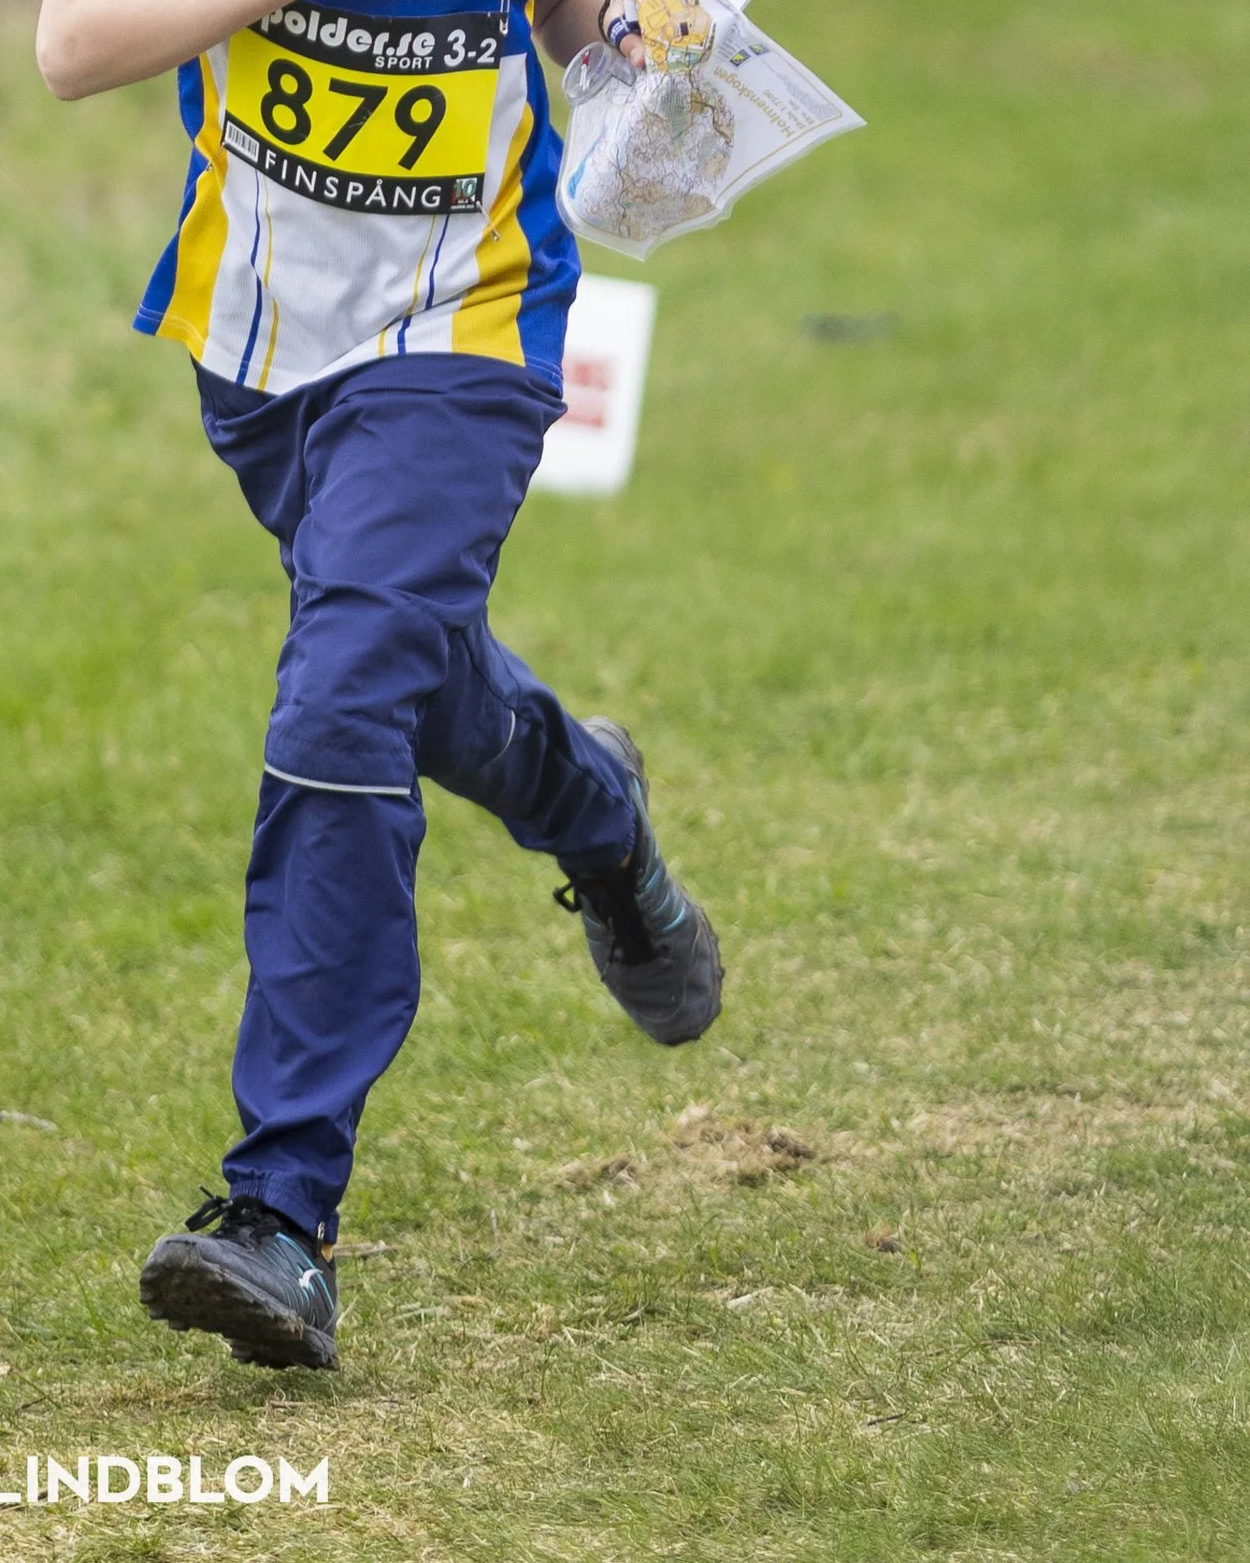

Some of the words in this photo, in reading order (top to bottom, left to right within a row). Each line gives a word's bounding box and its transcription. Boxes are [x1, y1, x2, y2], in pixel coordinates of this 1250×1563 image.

[260, 7, 435, 58] polder.se
[443, 28, 498, 67] 3-2
[374, 55, 434, 70] SPORT
[260, 58, 447, 172] 879
[712, 66, 796, 138] Holmenskogen
[265, 148, 442, 208] FINSPÅNG
